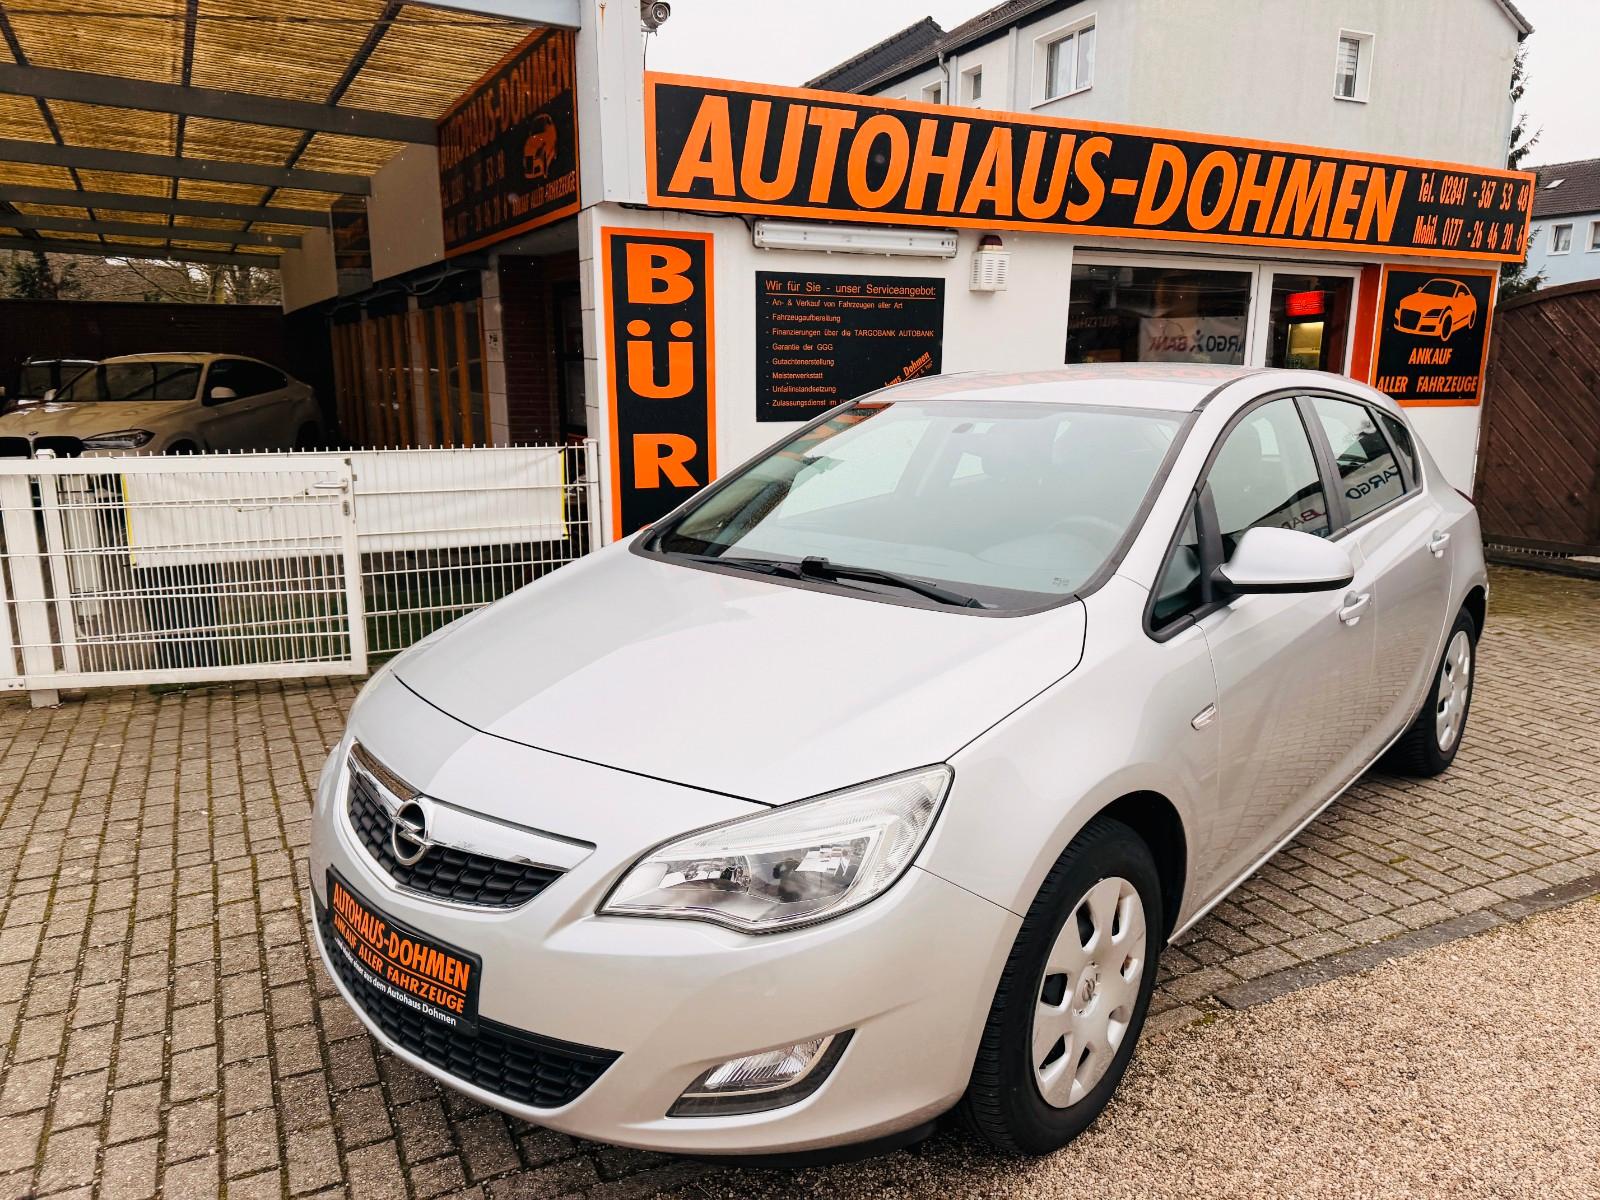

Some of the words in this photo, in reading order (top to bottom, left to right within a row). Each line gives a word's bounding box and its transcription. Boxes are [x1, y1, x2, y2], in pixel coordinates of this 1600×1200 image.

[668, 94, 1407, 242] AUTOHAUS-DOHMEN
[1418, 172, 1435, 202] Tel.
[1440, 175, 1469, 206] 02841
[1500, 183, 1513, 210] 53
[1518, 185, 1529, 212] 48
[1412, 215, 1439, 245] Mobil.
[1442, 218, 1464, 246] 0177
[1487, 222, 1500, 250] 46
[1501, 223, 1514, 250] 20
[766, 280, 782, 291] Wir
[787, 281, 800, 292] für
[806, 282, 820, 292] Sie
[835, 285, 861, 293] unser
[866, 284, 936, 297] Serviceangebot:
[796, 299, 821, 307] Verkauf
[838, 301, 875, 309] Fahrzeugen
[772, 313, 841, 323] Fahrzeugaufbereitung
[772, 327, 821, 338] Finanzierungen
[824, 328, 839, 336] über
[842, 329, 851, 337] die
[854, 329, 896, 337] TARGOBANK
[772, 342, 801, 351] Garantie
[803, 343, 813, 351] der
[816, 343, 834, 351] GGG
[772, 357, 835, 367] Gutachtenerstellung
[903, 351, 930, 377] Dohmen
[1408, 348, 1453, 365] ANKAUF
[772, 371, 824, 379] Meisterwerkstatt
[626, 243, 700, 529] BÜR
[772, 385, 837, 394] Unfallinstandsetzung
[1377, 376, 1408, 392] ALLER
[1416, 376, 1478, 392] FAHRZEUGE
[772, 399, 826, 408] Zulassungsdienst
[333, 882, 470, 991] AUTOHAUS-DOHMEN
[334, 914, 357, 949] ANKAUF
[358, 943, 383, 973] ALLER
[387, 965, 465, 1013] FAHRZEUGE
[363, 970, 373, 983] aus
[372, 978, 386, 993] dem
[386, 986, 421, 1010] Autohaus
[422, 1003, 457, 1026] Dohmen
